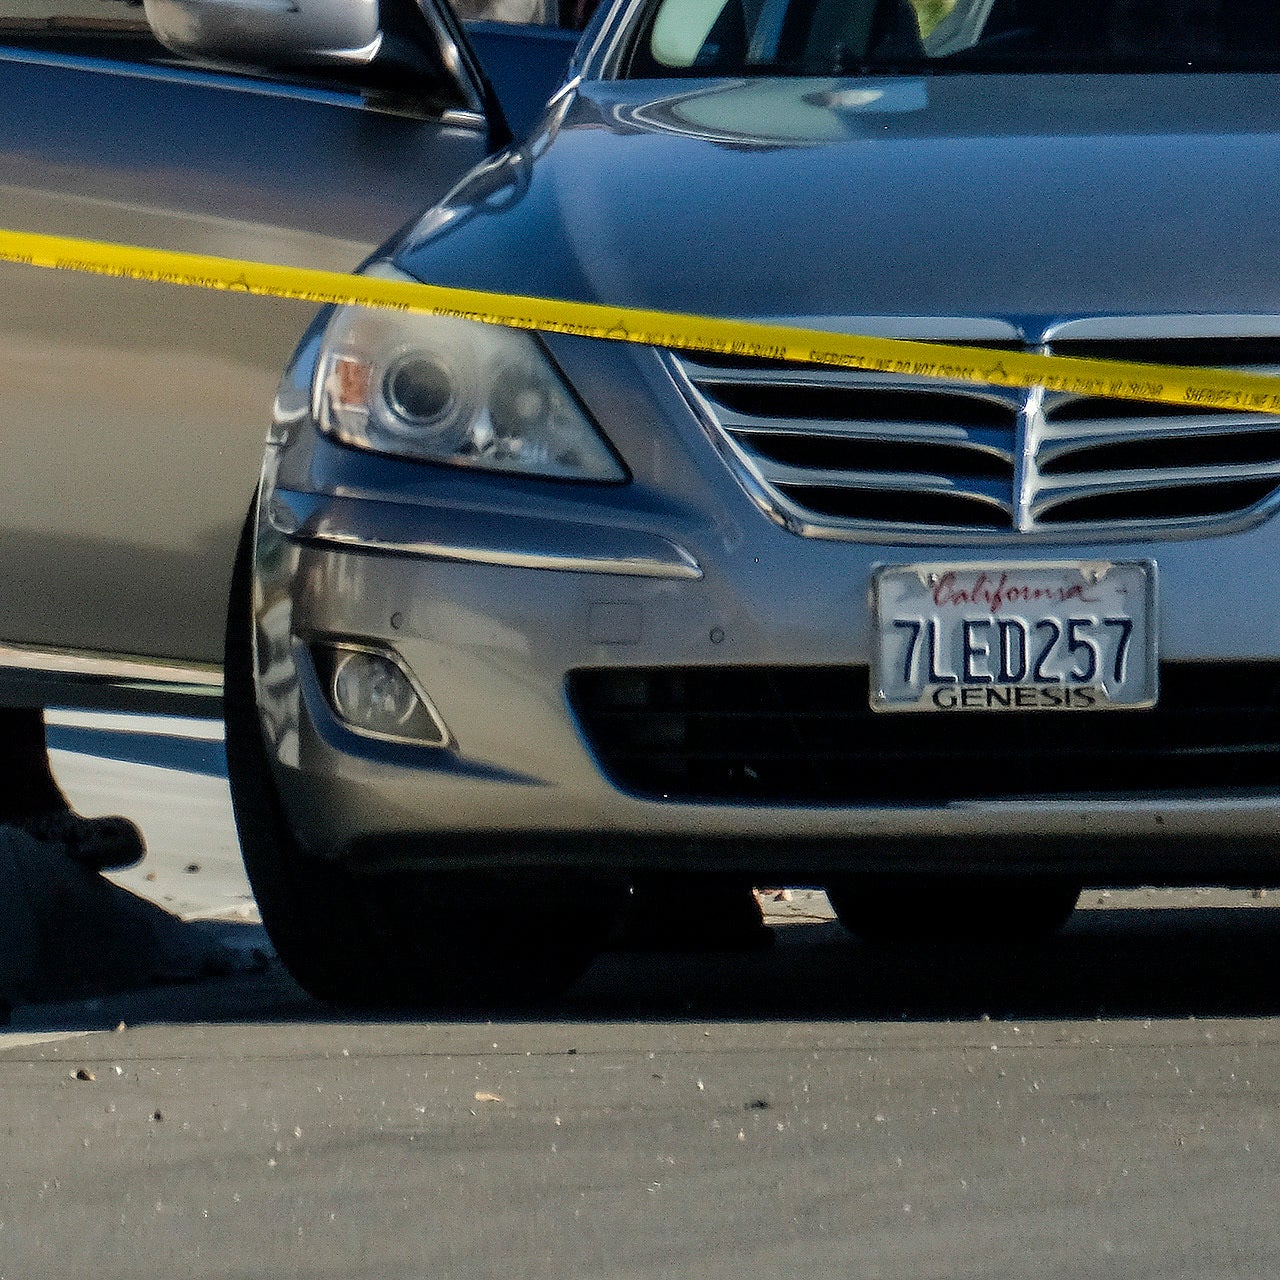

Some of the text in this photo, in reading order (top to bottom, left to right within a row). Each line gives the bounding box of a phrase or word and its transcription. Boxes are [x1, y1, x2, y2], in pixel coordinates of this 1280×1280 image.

[931, 572, 1098, 612] California
[893, 619, 1135, 684] 7LED257
[932, 686, 1096, 709] GENESIS
